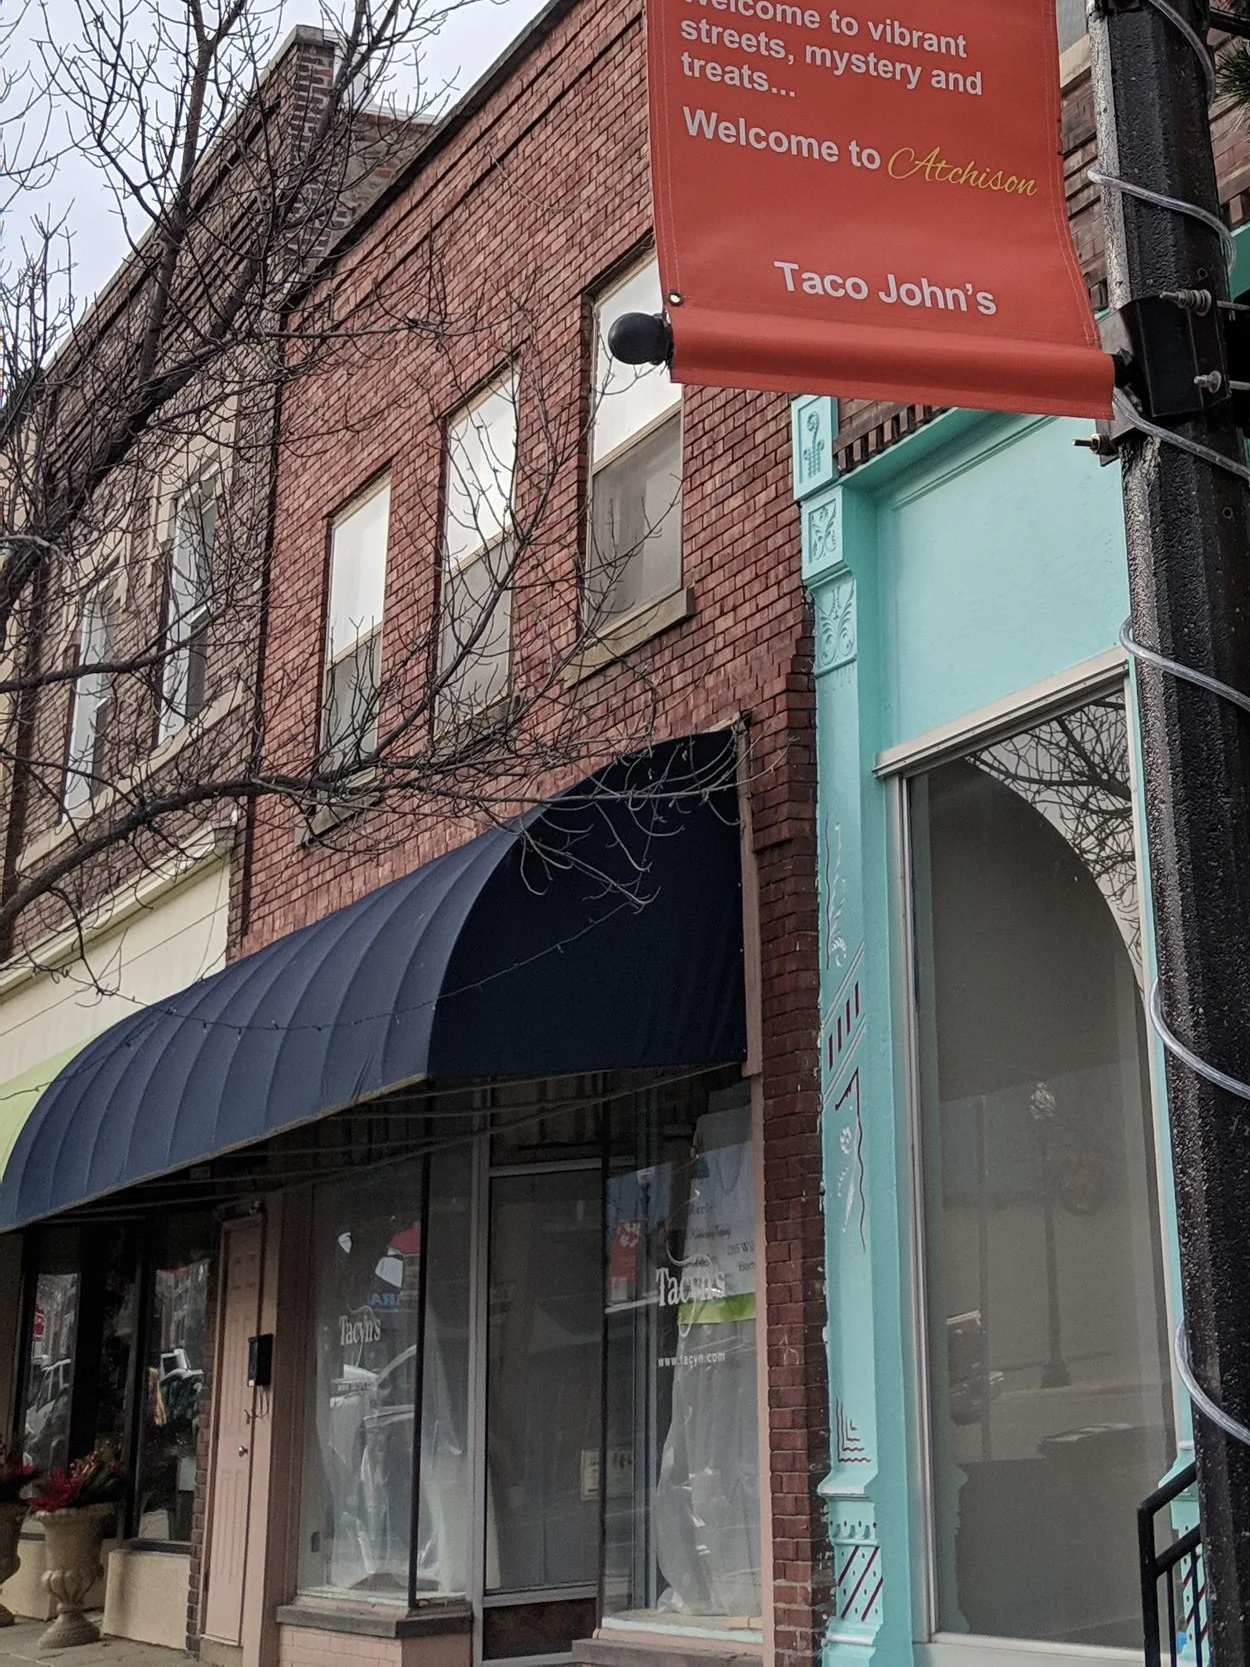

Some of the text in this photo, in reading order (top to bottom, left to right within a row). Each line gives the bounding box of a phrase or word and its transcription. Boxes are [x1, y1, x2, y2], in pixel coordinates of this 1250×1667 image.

[680, 18, 983, 96] streets, mystery and
[829, 9, 859, 36] to
[867, 18, 968, 58] vibrant
[681, 51, 796, 97] treats...
[682, 106, 1039, 196] Welcome to Atchison
[773, 260, 998, 316] Taco John's
